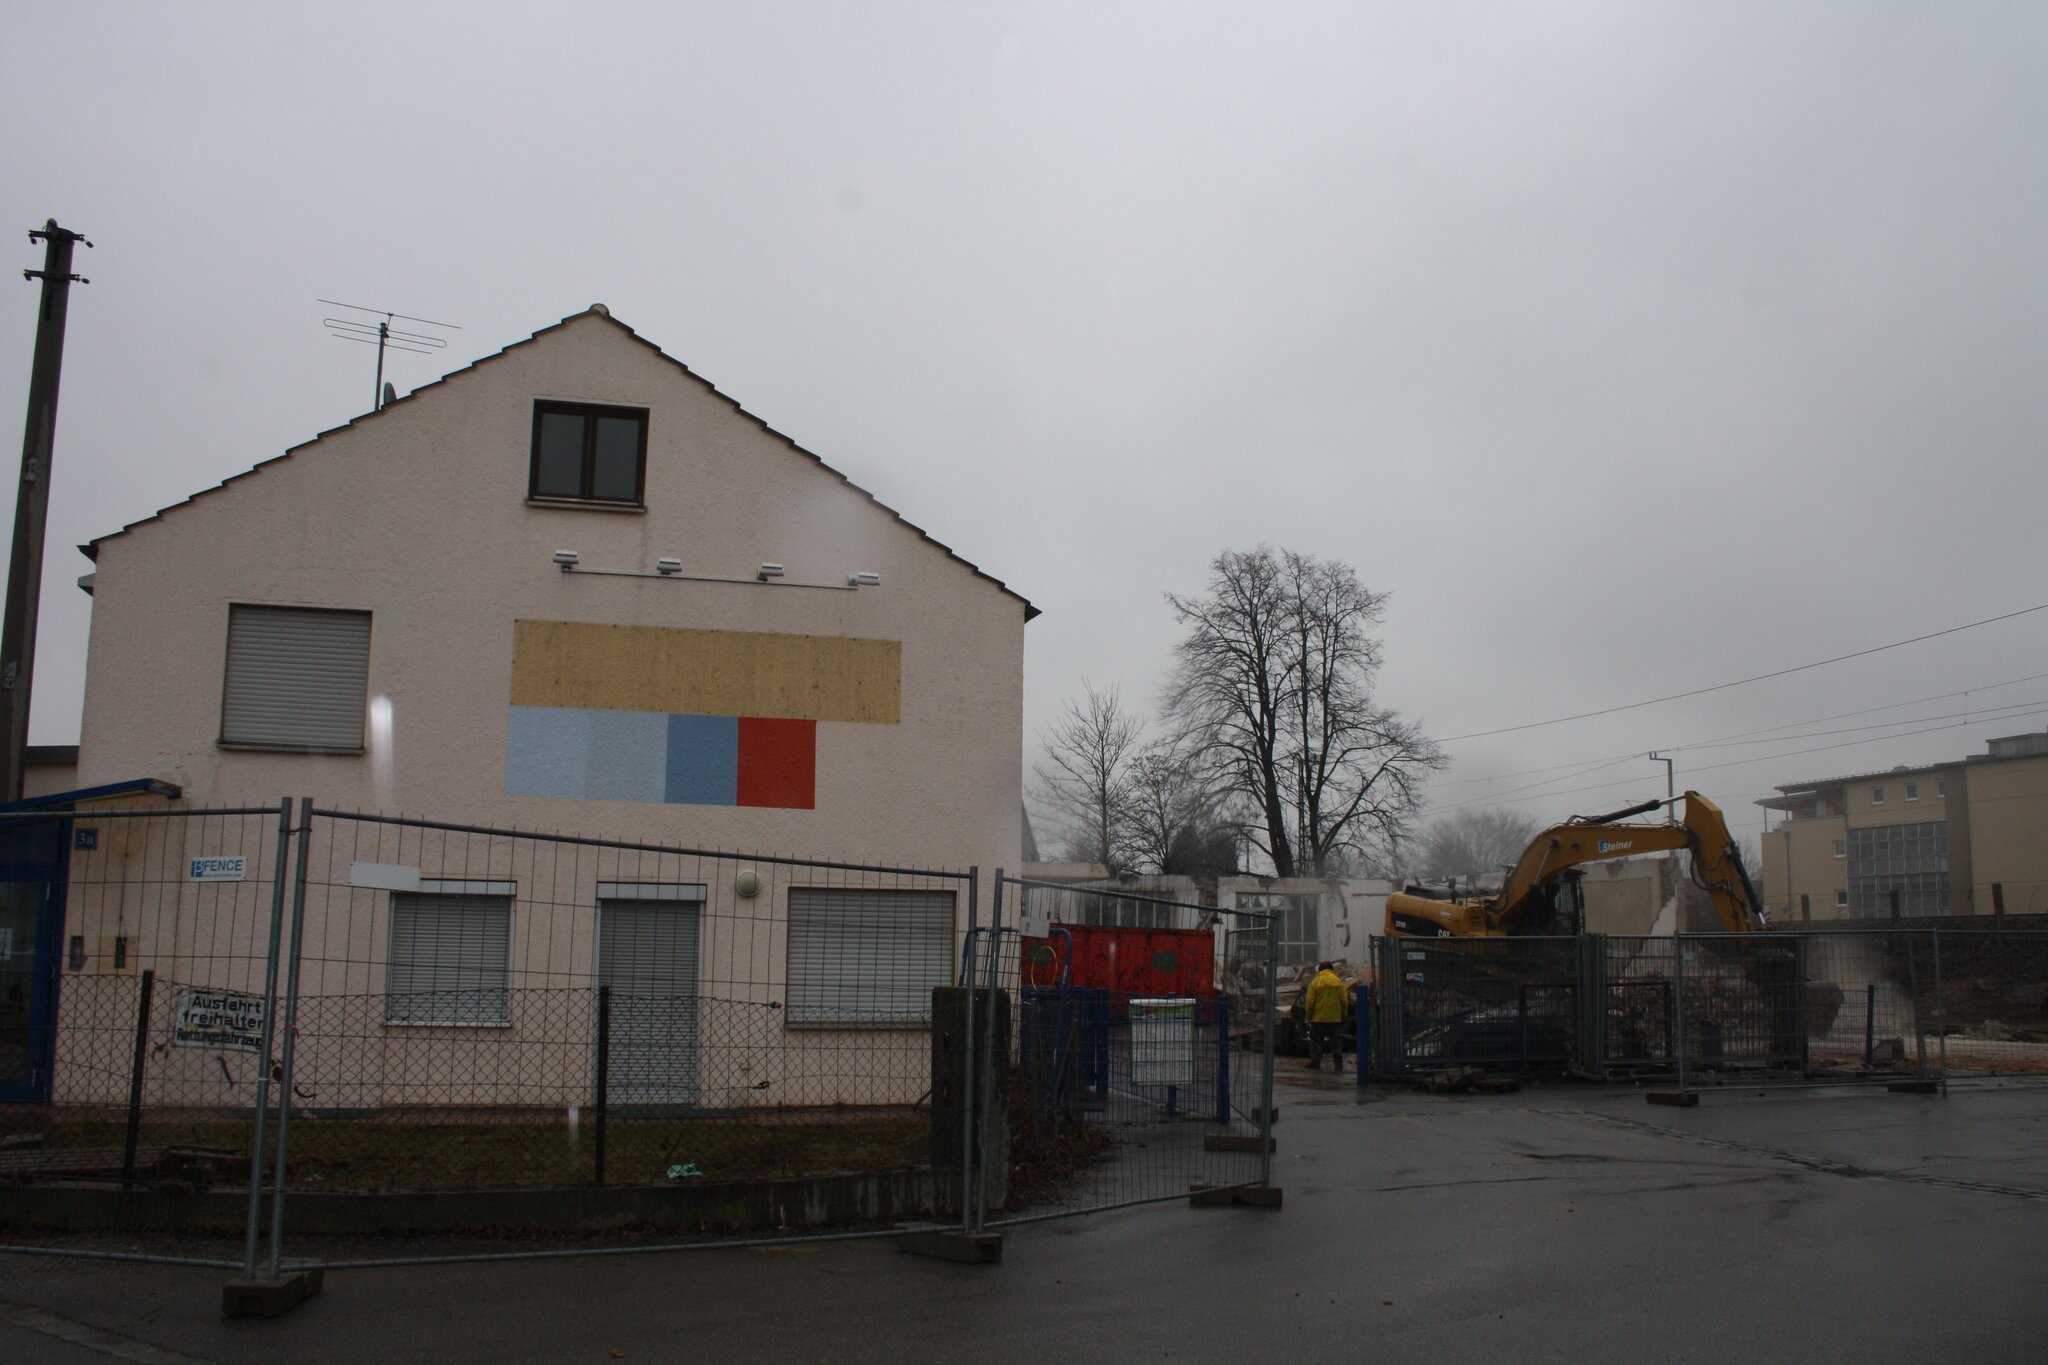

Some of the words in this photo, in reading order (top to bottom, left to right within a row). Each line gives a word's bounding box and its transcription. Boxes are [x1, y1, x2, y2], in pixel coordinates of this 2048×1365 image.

[79, 832, 94, 845] 3a
[1601, 840, 1633, 851] Steiner
[192, 996, 262, 1014] Ausfahrt
